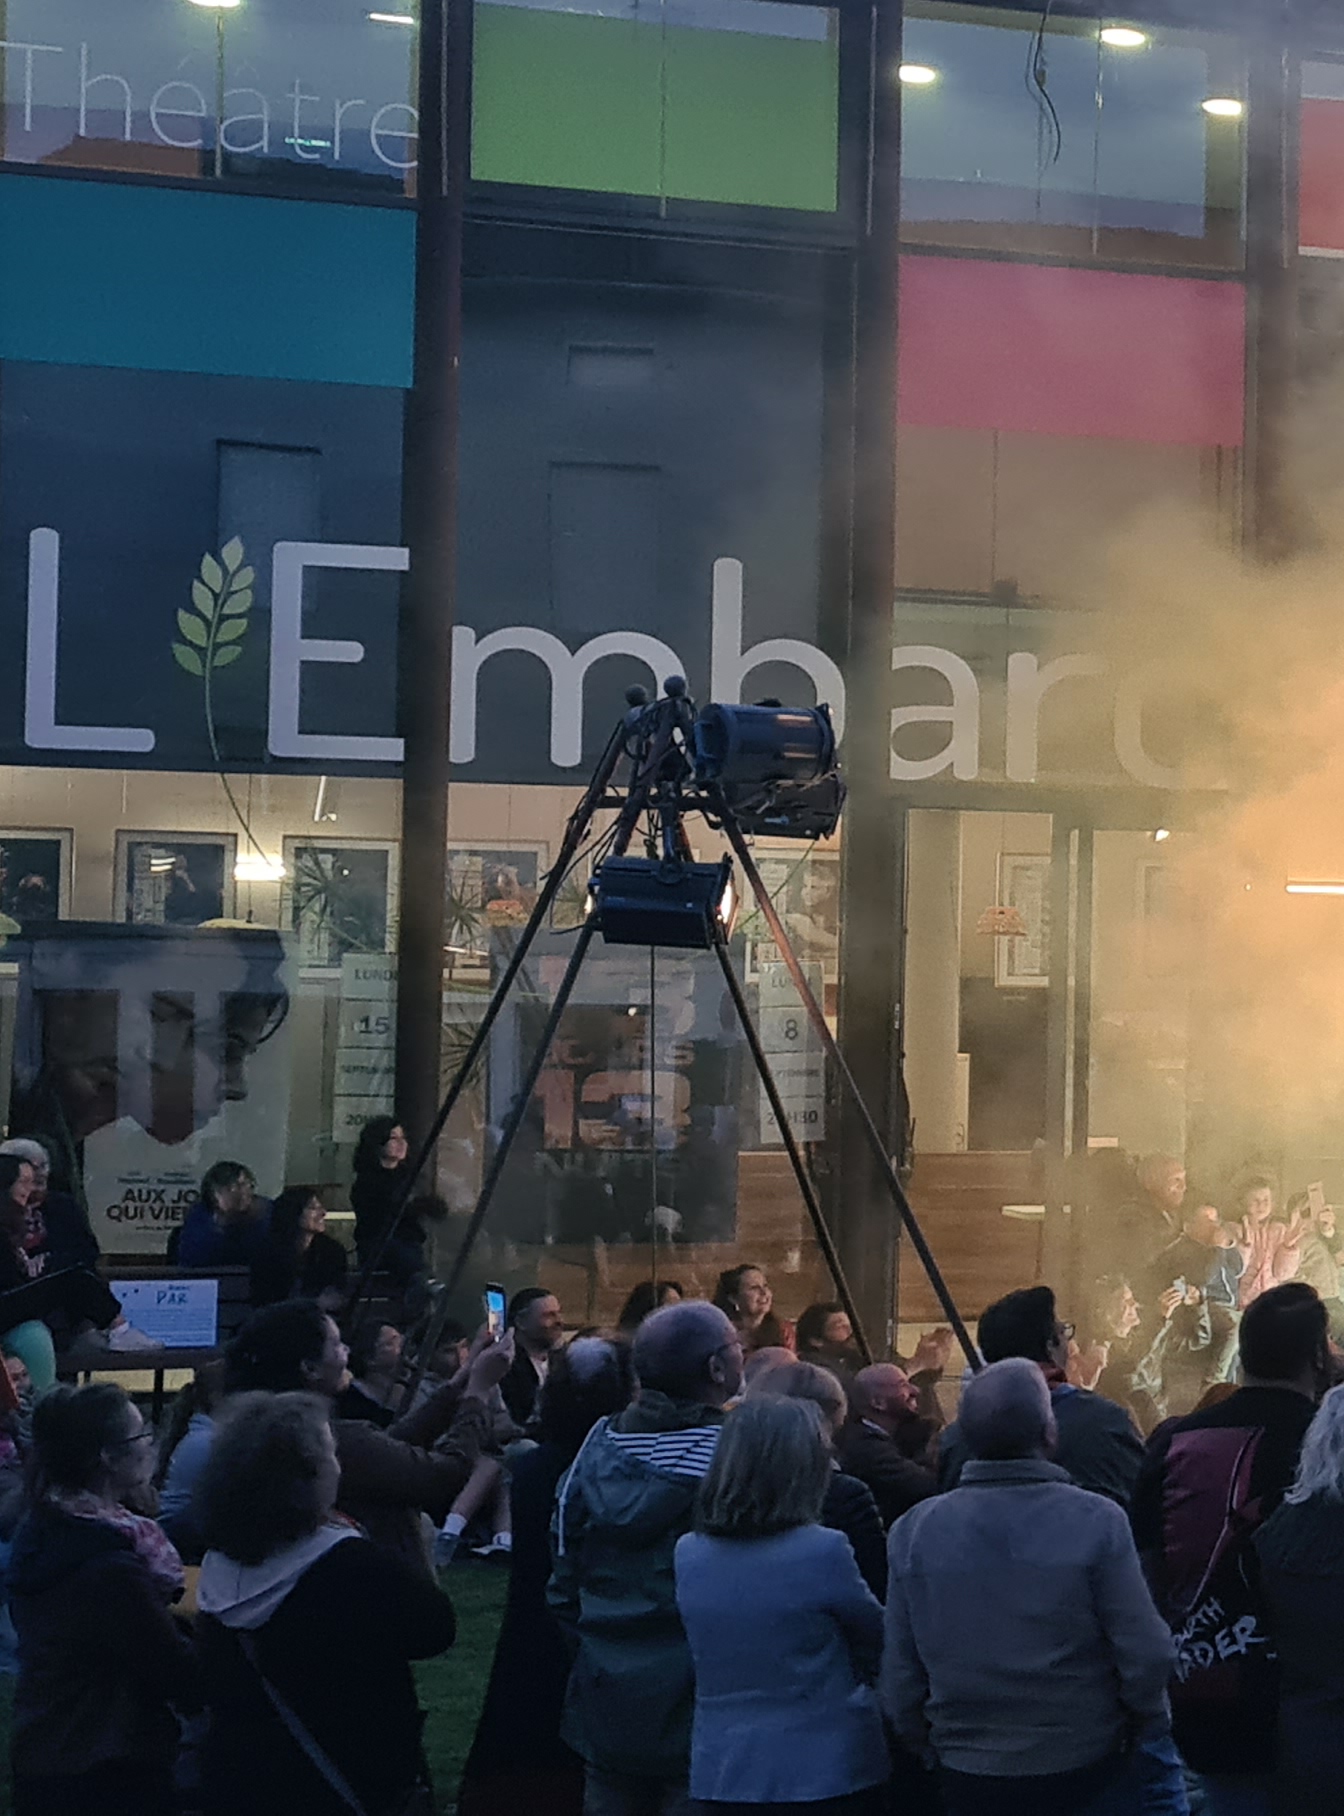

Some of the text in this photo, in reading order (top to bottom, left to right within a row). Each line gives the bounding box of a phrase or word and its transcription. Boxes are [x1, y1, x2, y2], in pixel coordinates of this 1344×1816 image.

[0, 40, 419, 169] Théâtre
[359, 1015, 390, 1035] 15
[784, 1018, 799, 1041] 8
[767, 1109, 819, 1126] 2H30
[121, 1187, 166, 1204] AUX
[106, 1203, 145, 1223] QUI
[1174, 1615, 1269, 1684] ADER
